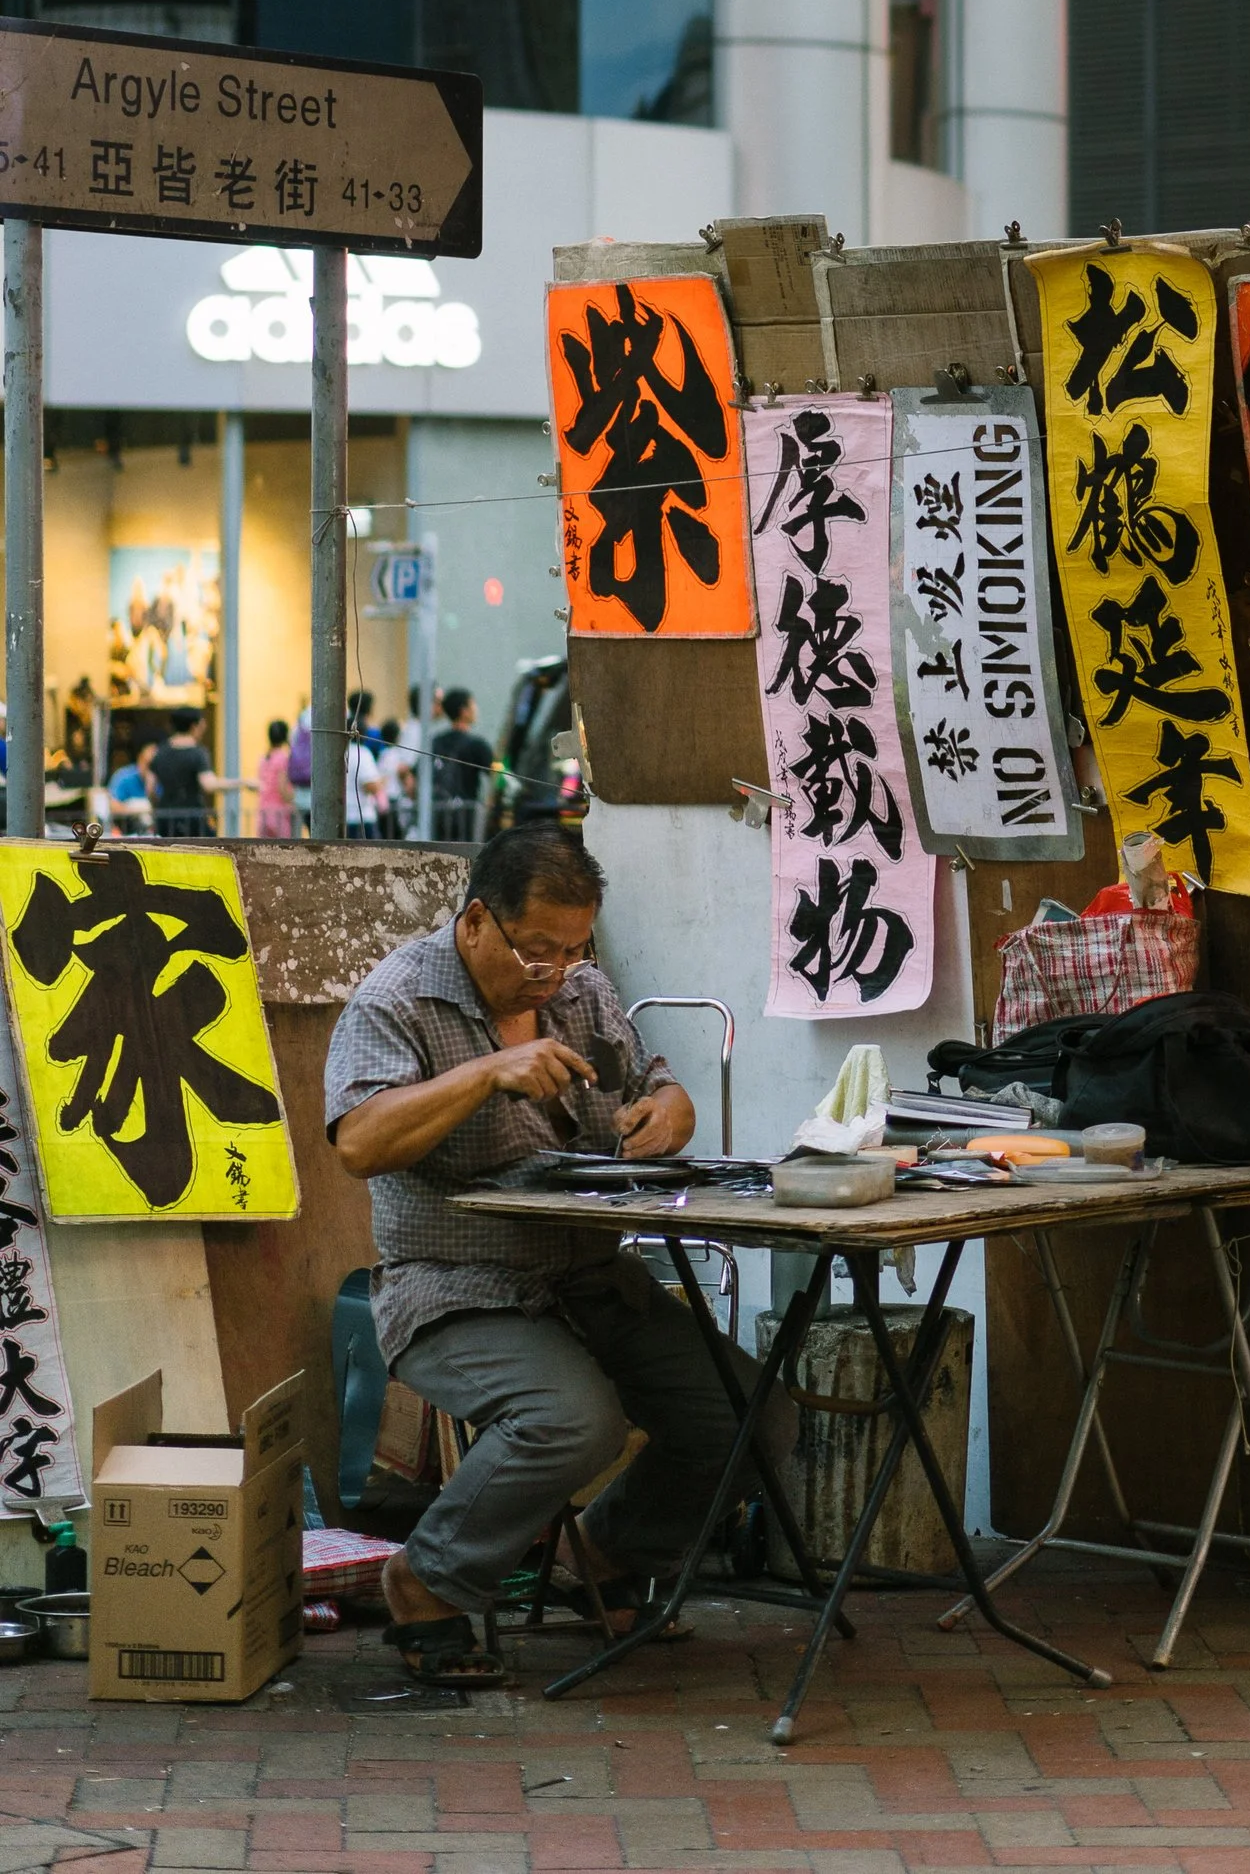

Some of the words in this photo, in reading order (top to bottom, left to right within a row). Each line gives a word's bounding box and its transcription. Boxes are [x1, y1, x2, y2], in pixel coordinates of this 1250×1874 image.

[70, 57, 201, 119] Argyle
[217, 73, 338, 129] Street
[88, 138, 320, 217] 亞皆老街
[186, 284, 482, 369] addas
[560, 283, 728, 633] 紫
[972, 423, 1036, 720] SMOKING
[1064, 261, 1241, 875] 松鶴延年
[913, 470, 981, 784] 禁止吸煙
[753, 409, 914, 1004] 厚德載物
[992, 746, 1056, 826] NO
[13, 849, 280, 1209] 家
[125, 1543, 149, 1555] KAO
[172, 1502, 225, 1517] 193290
[103, 1556, 174, 1578] Bleach
